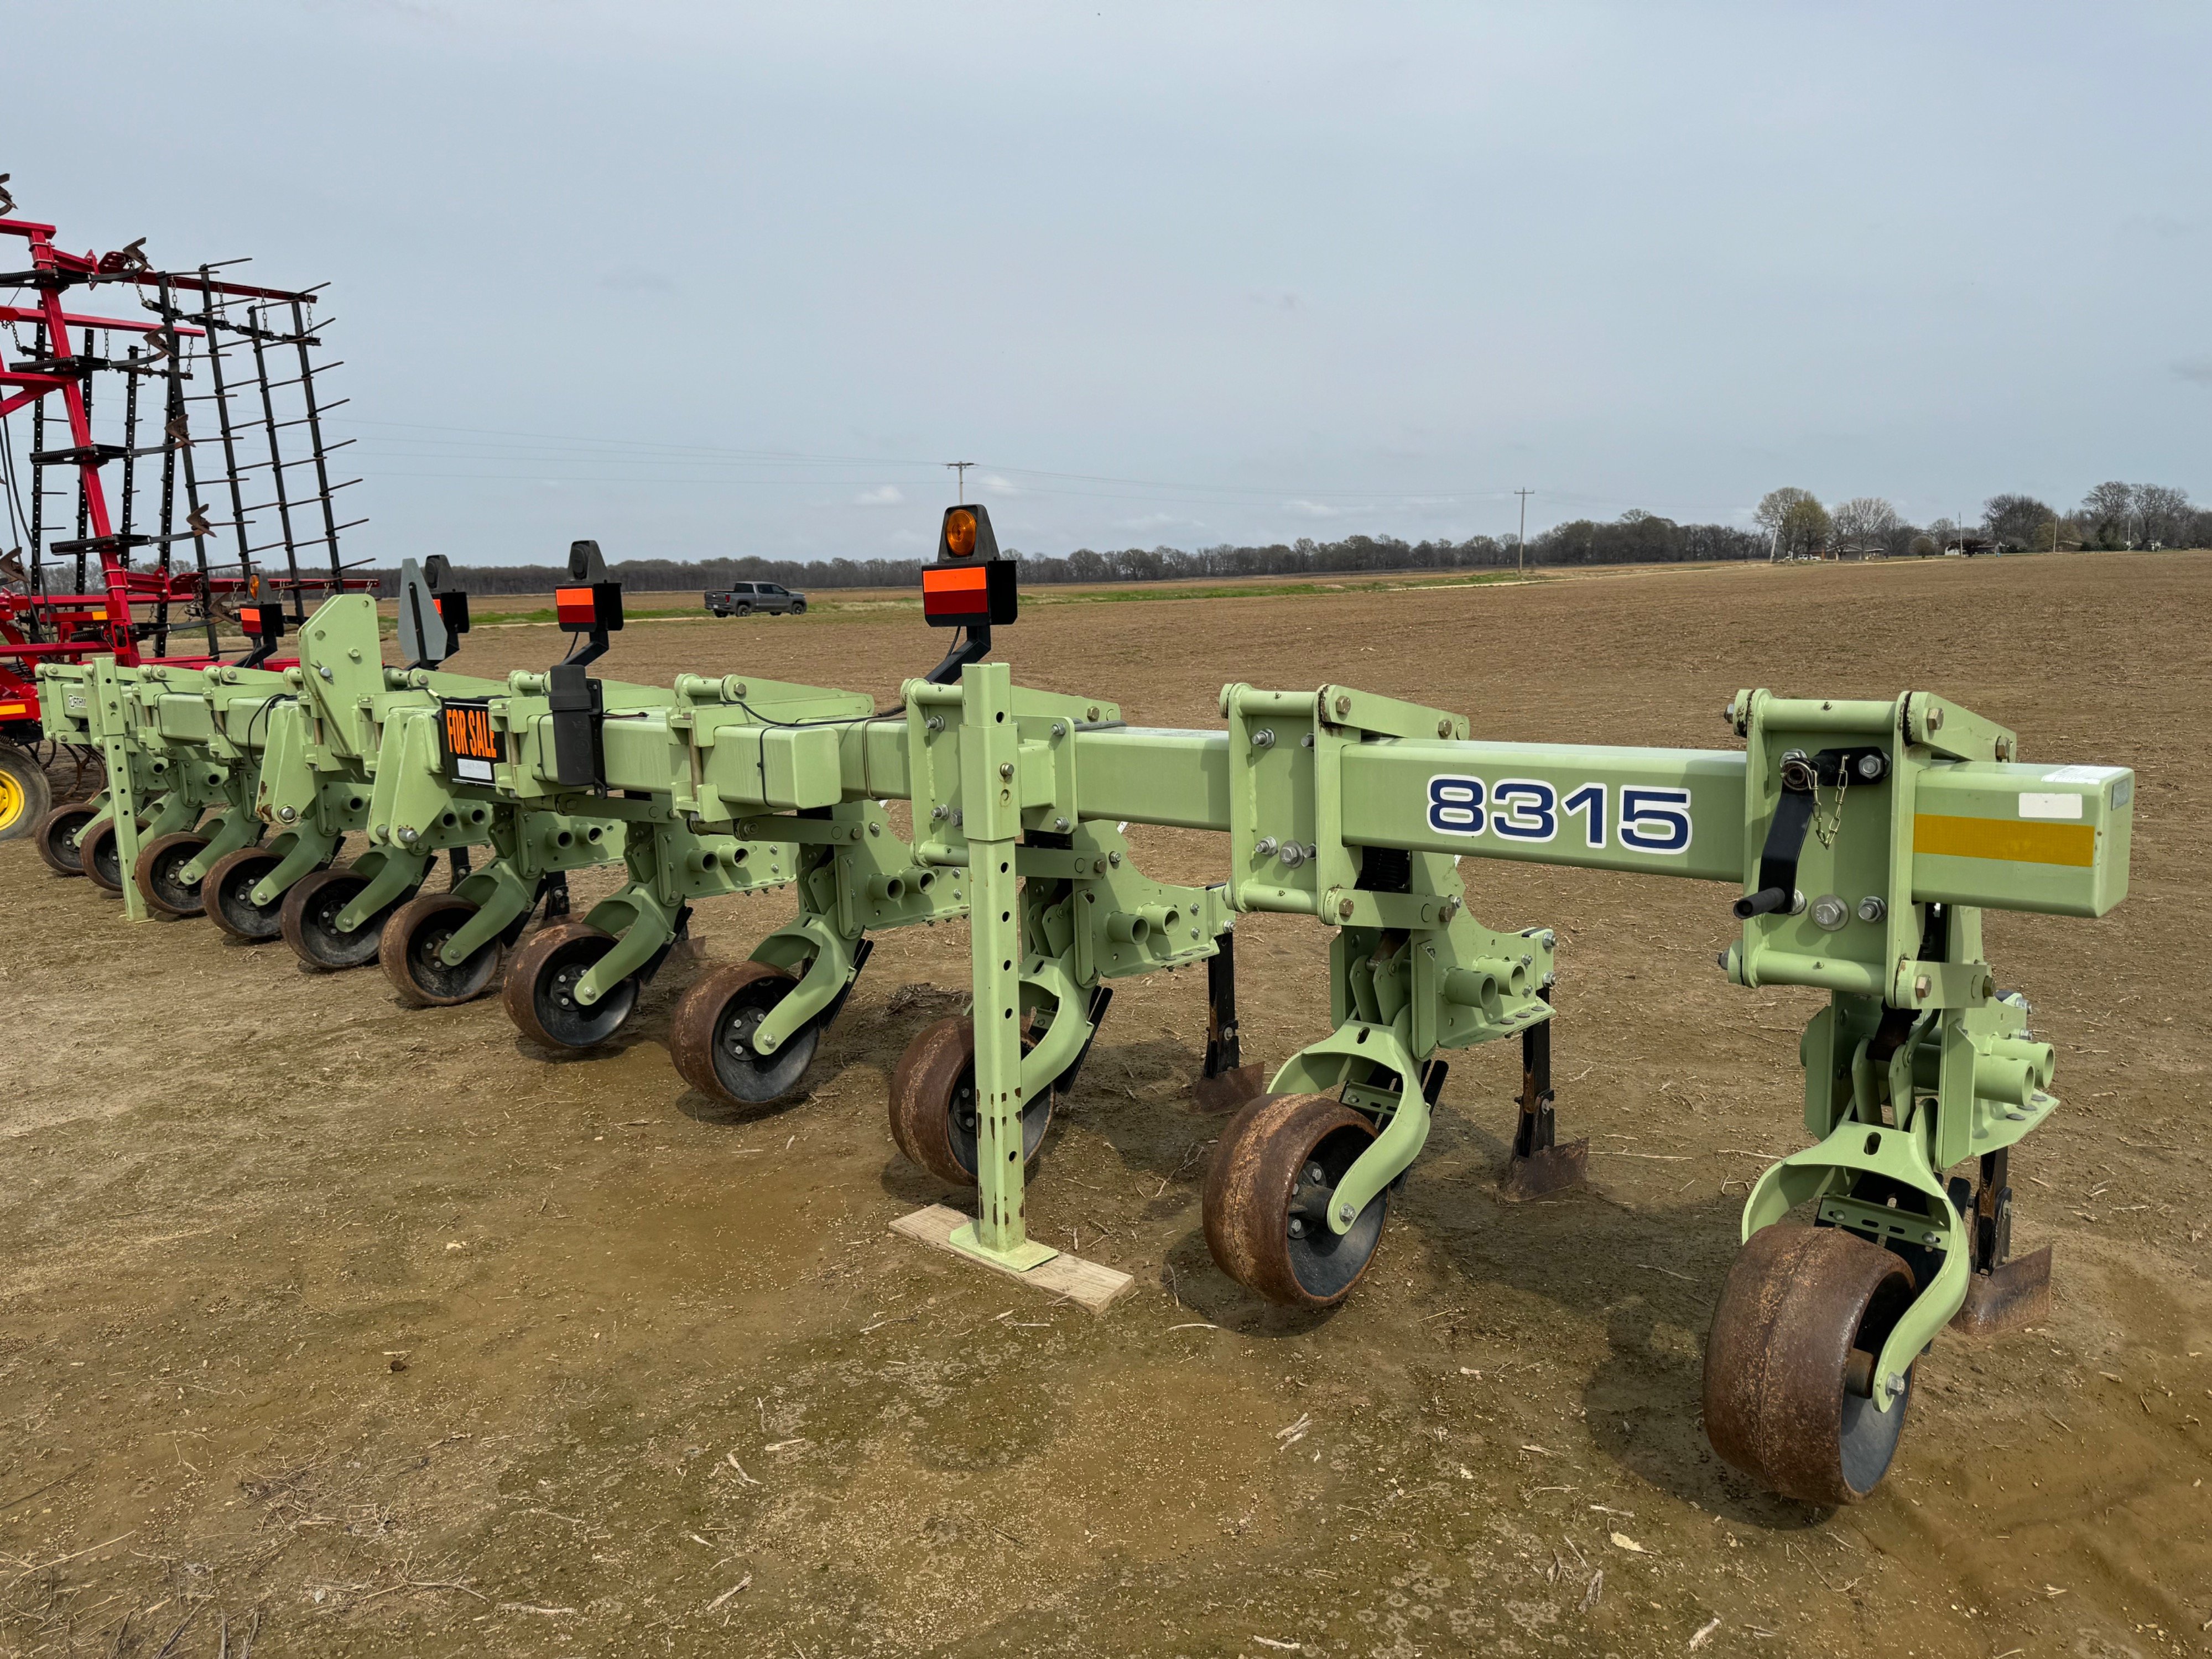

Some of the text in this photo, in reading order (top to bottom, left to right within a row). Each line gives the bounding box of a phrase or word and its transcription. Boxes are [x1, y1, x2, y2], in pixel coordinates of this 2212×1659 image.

[446, 709, 497, 758] FOR SALE
[1427, 774, 1693, 855] 8315
